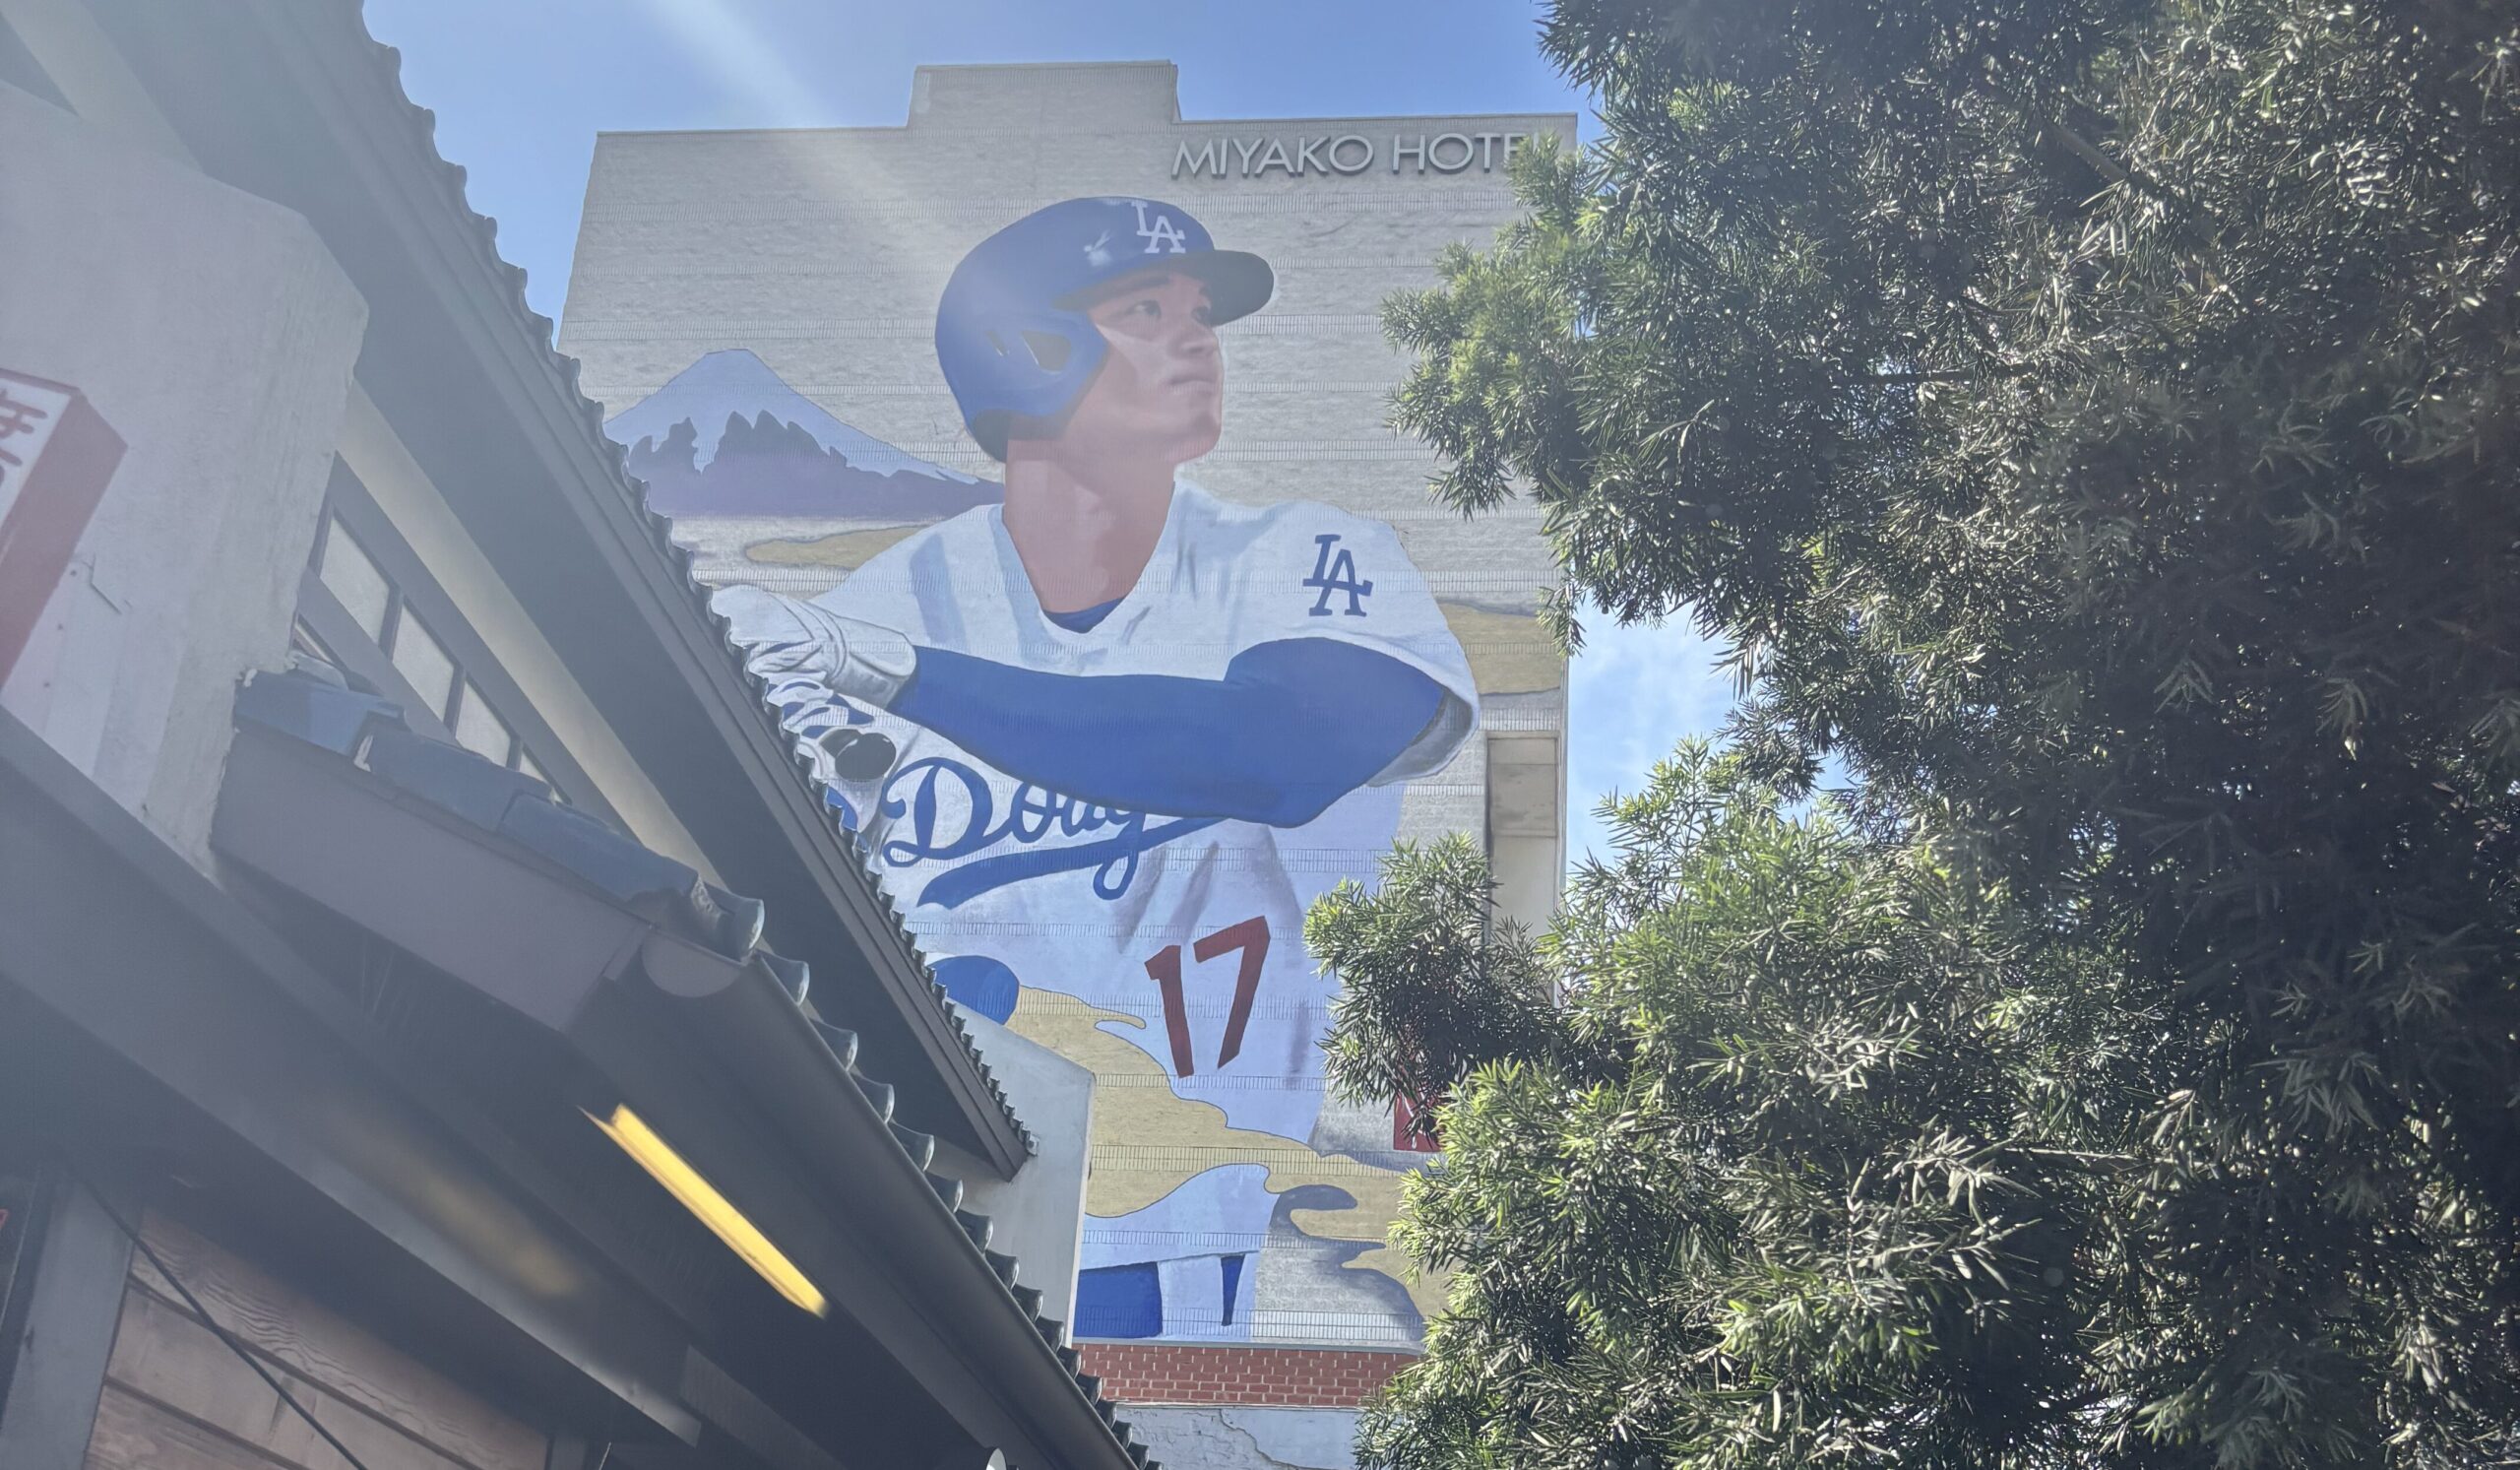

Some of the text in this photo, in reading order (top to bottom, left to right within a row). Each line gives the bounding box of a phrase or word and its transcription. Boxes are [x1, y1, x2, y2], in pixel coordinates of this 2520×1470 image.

[1171, 134, 1374, 179] MIYAKO
[1131, 200, 1186, 254] LA
[1302, 534, 1373, 617] LA
[1144, 915, 1271, 1079] 17
